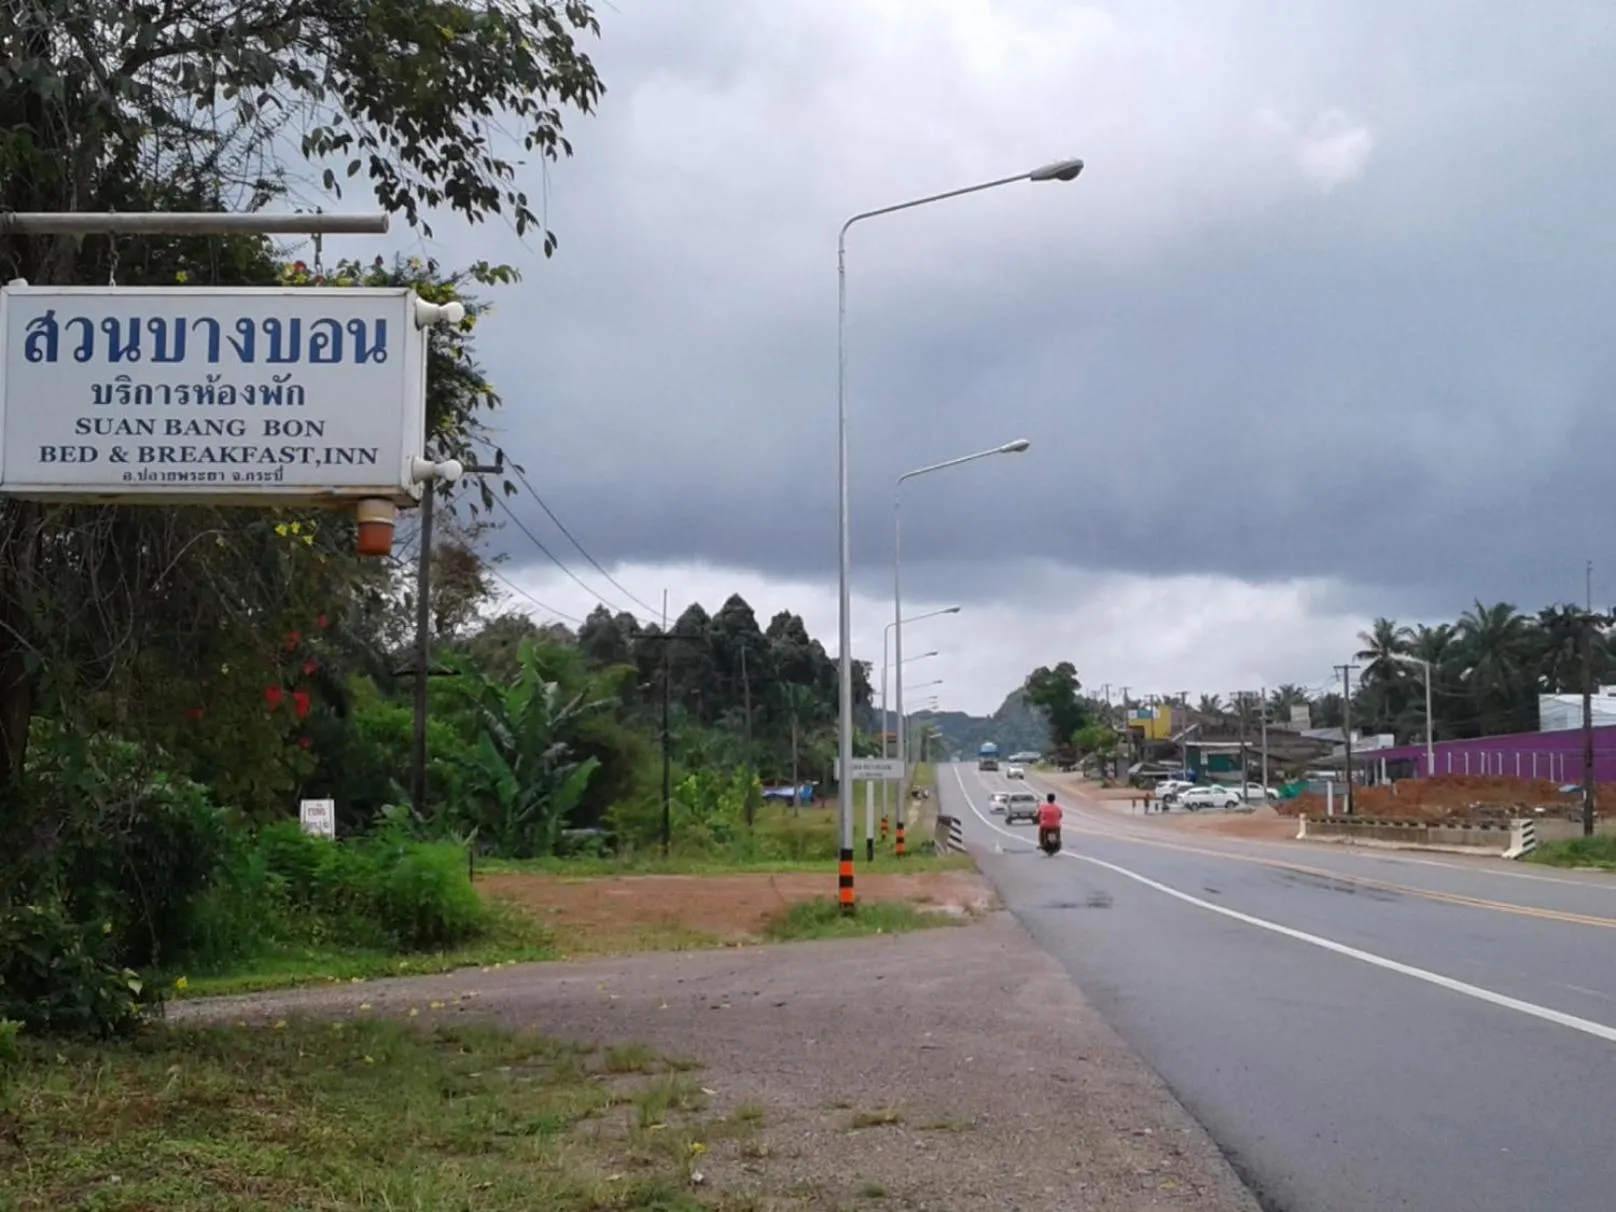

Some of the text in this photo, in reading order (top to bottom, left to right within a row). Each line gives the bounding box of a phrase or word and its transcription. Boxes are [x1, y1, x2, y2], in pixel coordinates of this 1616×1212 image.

[24, 309, 388, 364] สวนบางบอน
[91, 373, 305, 406] บริการห้องพัก
[75, 418, 325, 437] SUAN BANG BON
[39, 446, 378, 467] BED & BREAKFAST,INN
